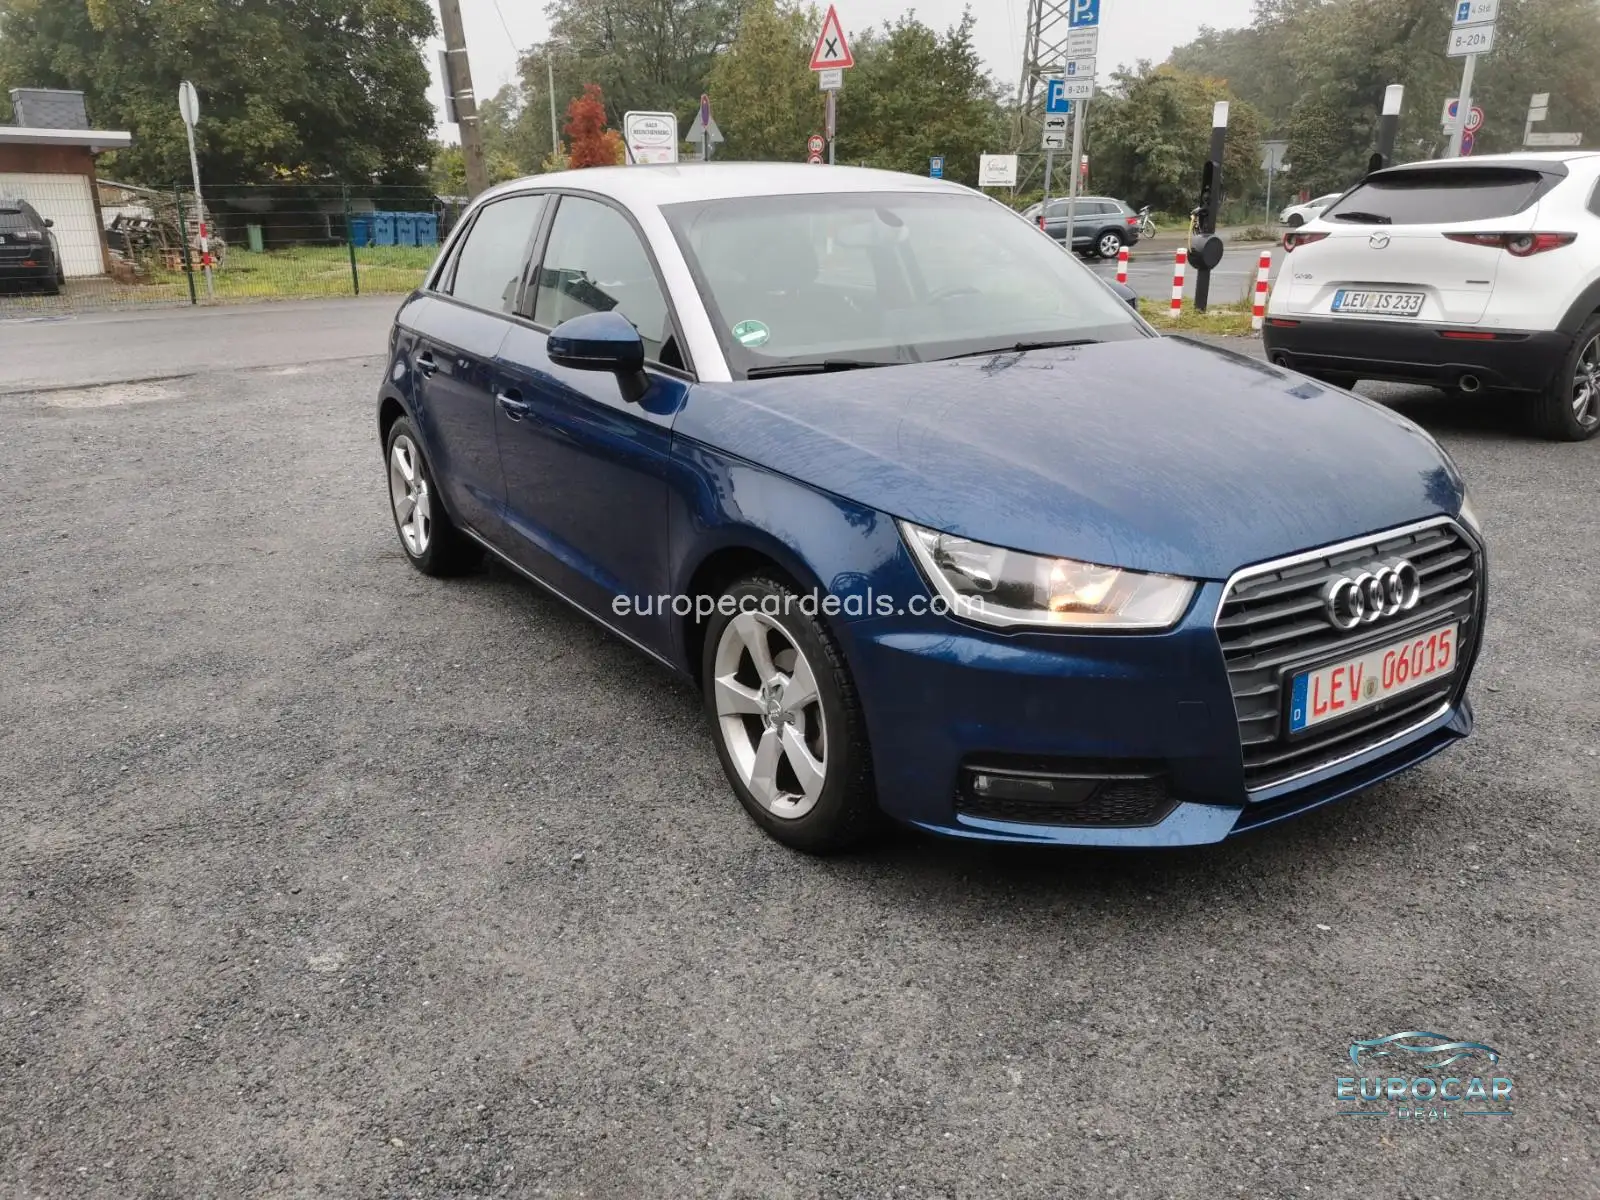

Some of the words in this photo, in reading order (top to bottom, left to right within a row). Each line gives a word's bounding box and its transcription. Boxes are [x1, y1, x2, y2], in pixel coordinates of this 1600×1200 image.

[1342, 293, 1369, 308] LEV
[1374, 294, 1392, 308] IS
[1393, 295, 1420, 309] 233
[1313, 661, 1363, 716] LEV
[1382, 629, 1452, 689] 06015
